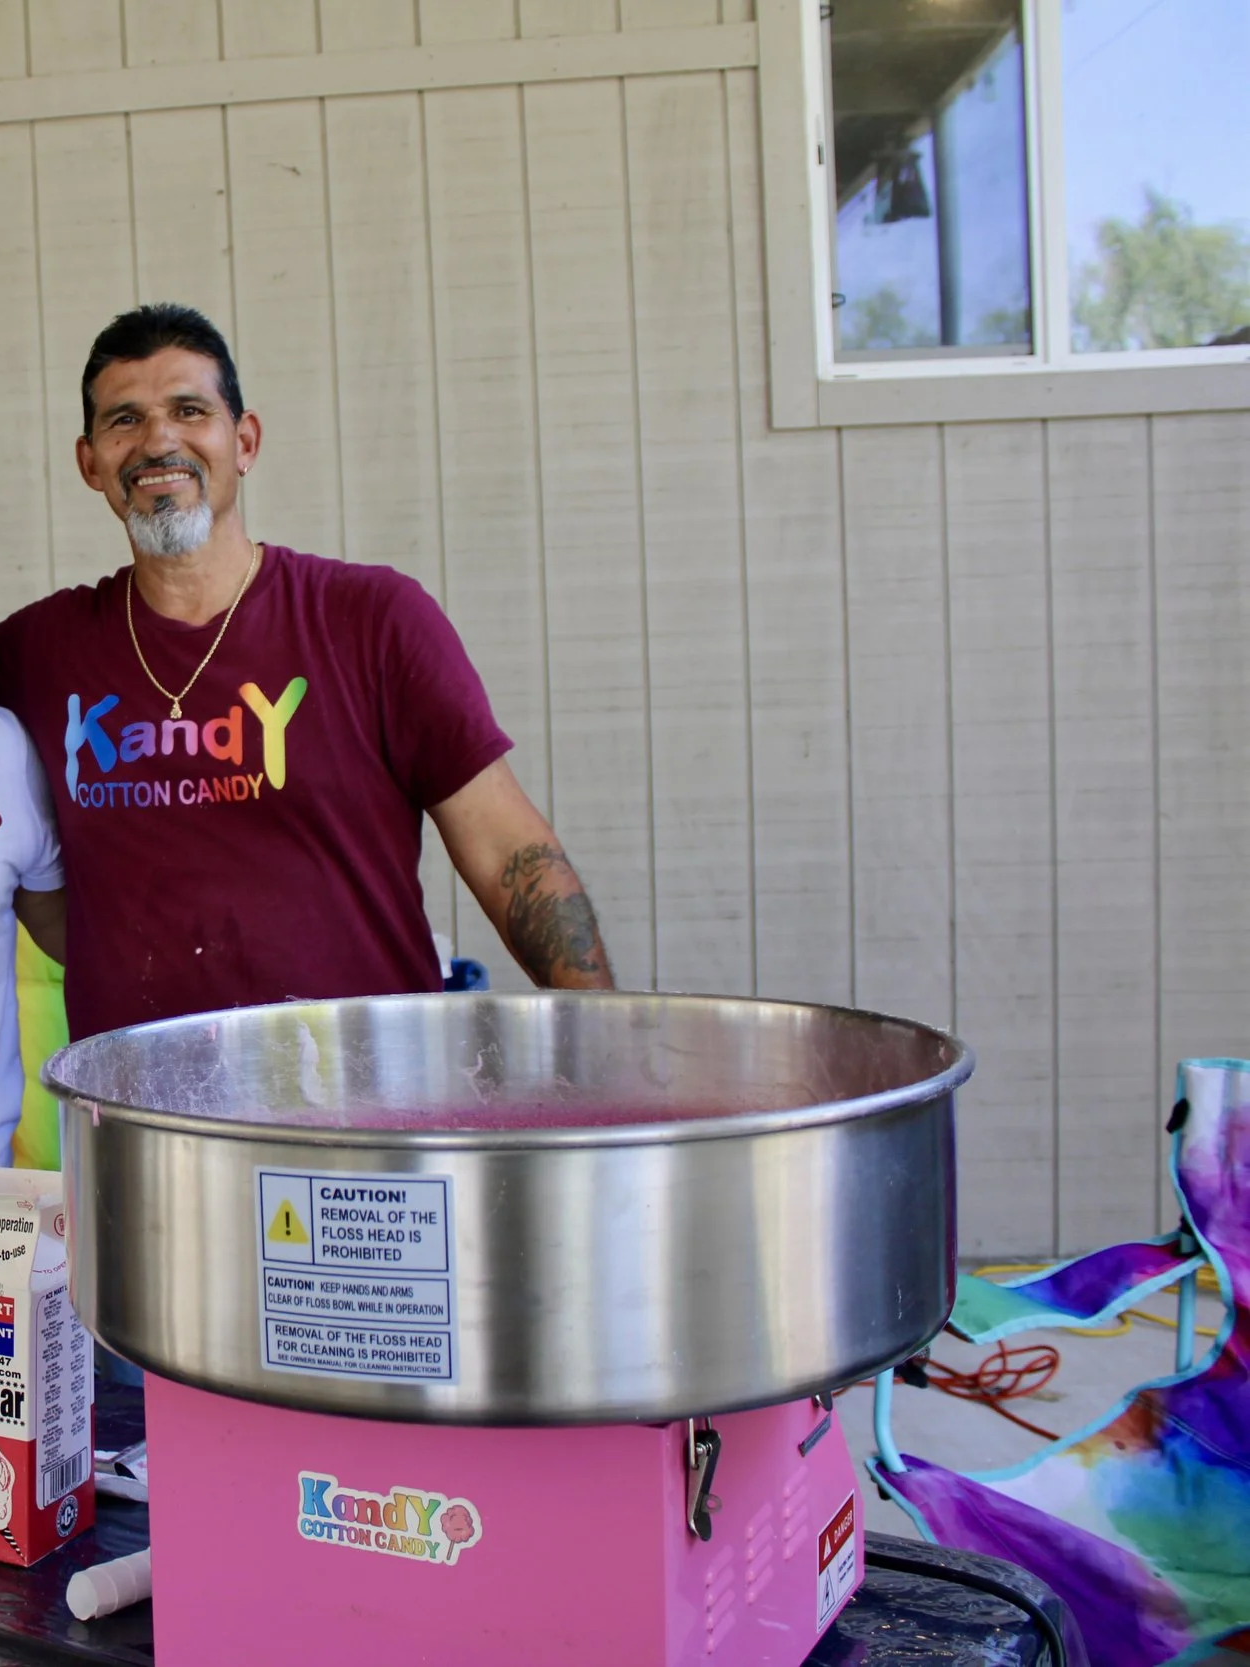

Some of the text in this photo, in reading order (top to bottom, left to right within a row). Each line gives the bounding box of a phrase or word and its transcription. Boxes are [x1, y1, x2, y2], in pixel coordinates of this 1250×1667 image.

[77, 772, 264, 808] COTTON CANDY
[320, 1188, 406, 1203] CAUTION!
[321, 1207, 437, 1224] REMOVAL OF THE
[322, 1226, 422, 1243] FLOSS HEAD IS
[322, 1245, 402, 1261] PROHIBITED
[268, 1277, 413, 1298] CAUTION! KEEP HANDS AND ARMS
[268, 1293, 443, 1316] CLEAR OF FLOSS BOWL WHILE IN OPERATION
[275, 1324, 442, 1348] REMOVAL OF THE FLOSS HEAD
[277, 1340, 441, 1363] FOR CLEANING IS PROHIBITED
[278, 1353, 289, 1361] SEE
[290, 1355, 316, 1364] OWNERS
[318, 1358, 343, 1367] MANUAL
[359, 1362, 391, 1371] CLEANING
[393, 1365, 441, 1373] INSTRUCTIONS
[834, 1510, 853, 1544] DANGER
[301, 1518, 440, 1559] COTTON CANDY
